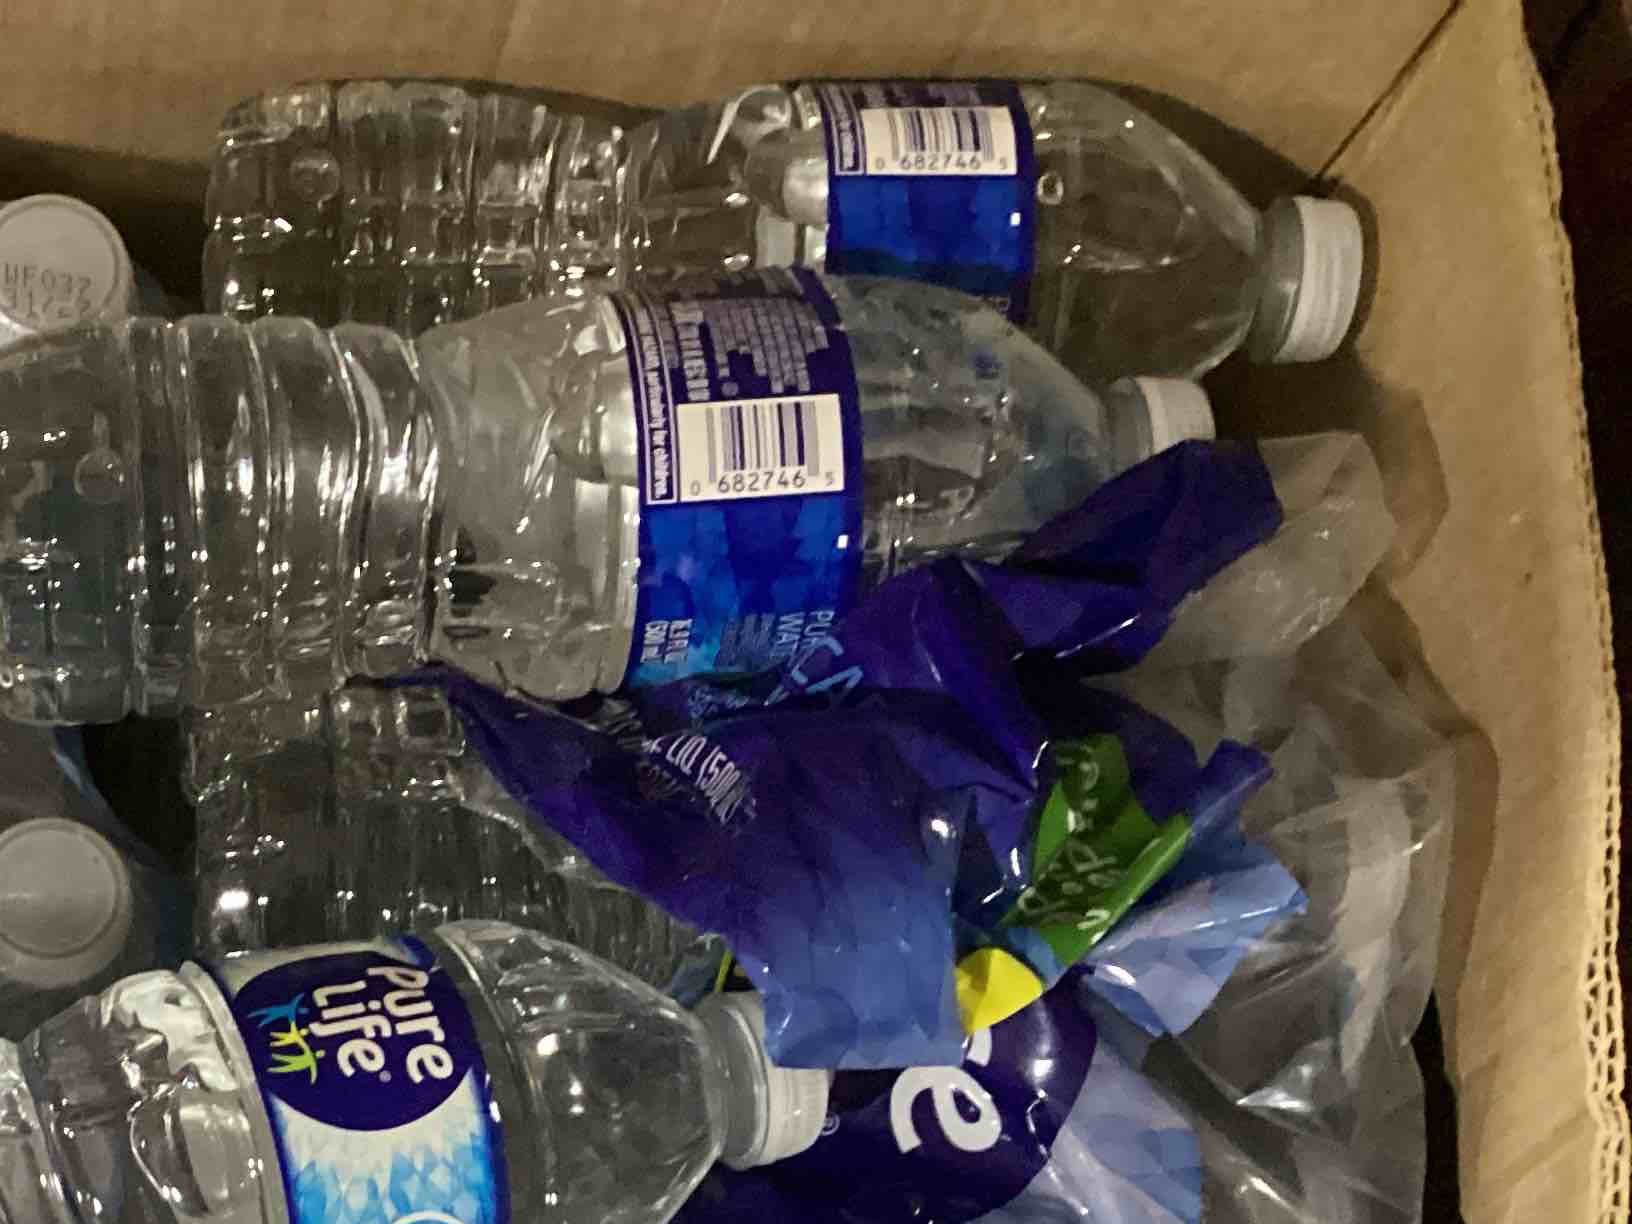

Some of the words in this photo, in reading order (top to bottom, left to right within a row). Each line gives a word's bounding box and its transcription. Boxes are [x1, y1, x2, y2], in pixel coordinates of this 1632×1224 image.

[900, 152, 981, 171] 682746
[718, 470, 806, 493] 682746
[309, 980, 391, 1079] Life
[366, 966, 454, 1084] Pure
